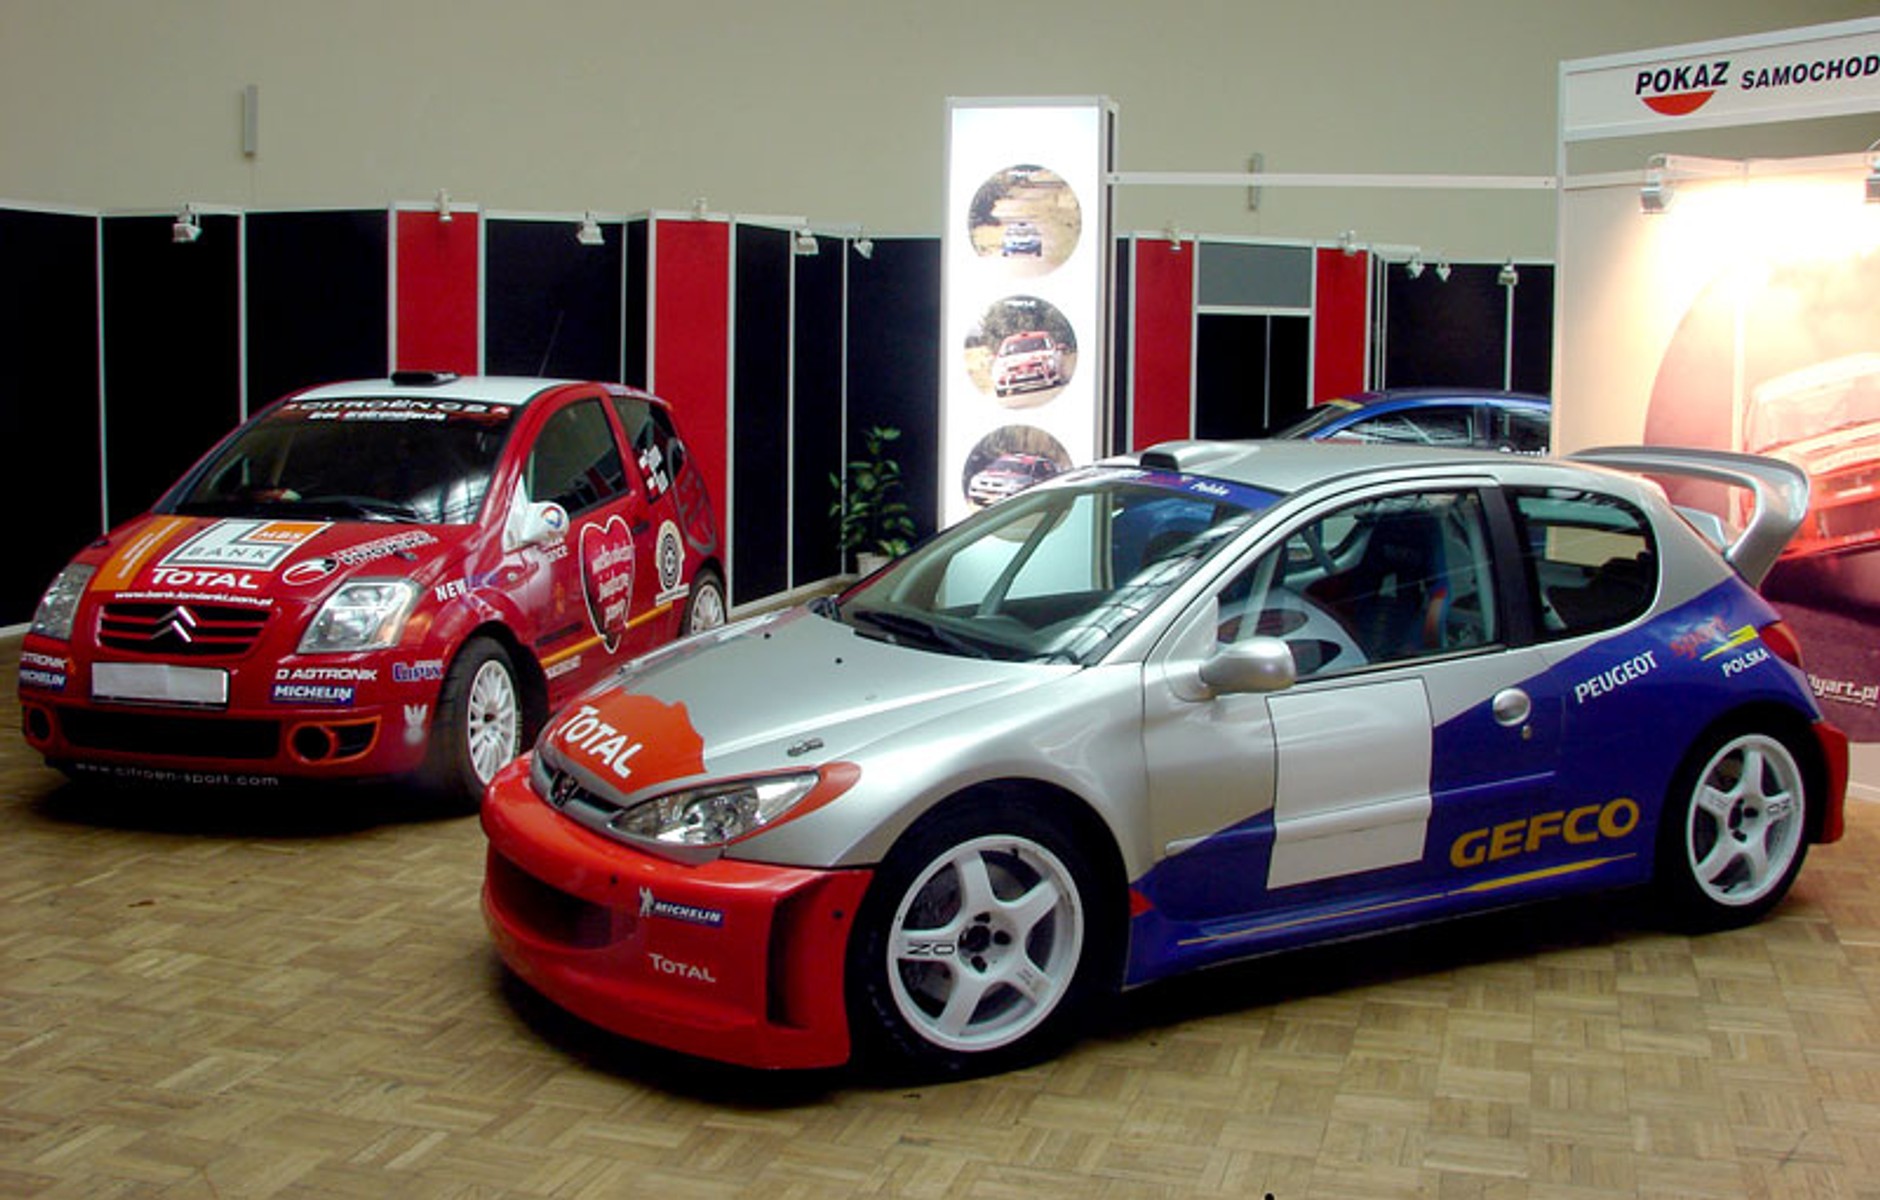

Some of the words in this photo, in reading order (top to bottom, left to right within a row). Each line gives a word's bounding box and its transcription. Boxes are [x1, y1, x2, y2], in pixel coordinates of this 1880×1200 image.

[1635, 61, 1730, 95] POKAZ
[1741, 55, 1880, 90] SAMOCHOD
[186, 546, 271, 559] BANK
[152, 568, 259, 589] TOTAL
[1574, 651, 1658, 704] PEUGEOT
[1722, 648, 1771, 678] POLSKA
[274, 685, 353, 699] MICHELIN
[557, 705, 643, 779] TOTAL
[1449, 797, 1640, 868] GEFCO
[655, 901, 722, 922] MICHELIN
[648, 952, 716, 983] TOTAL
